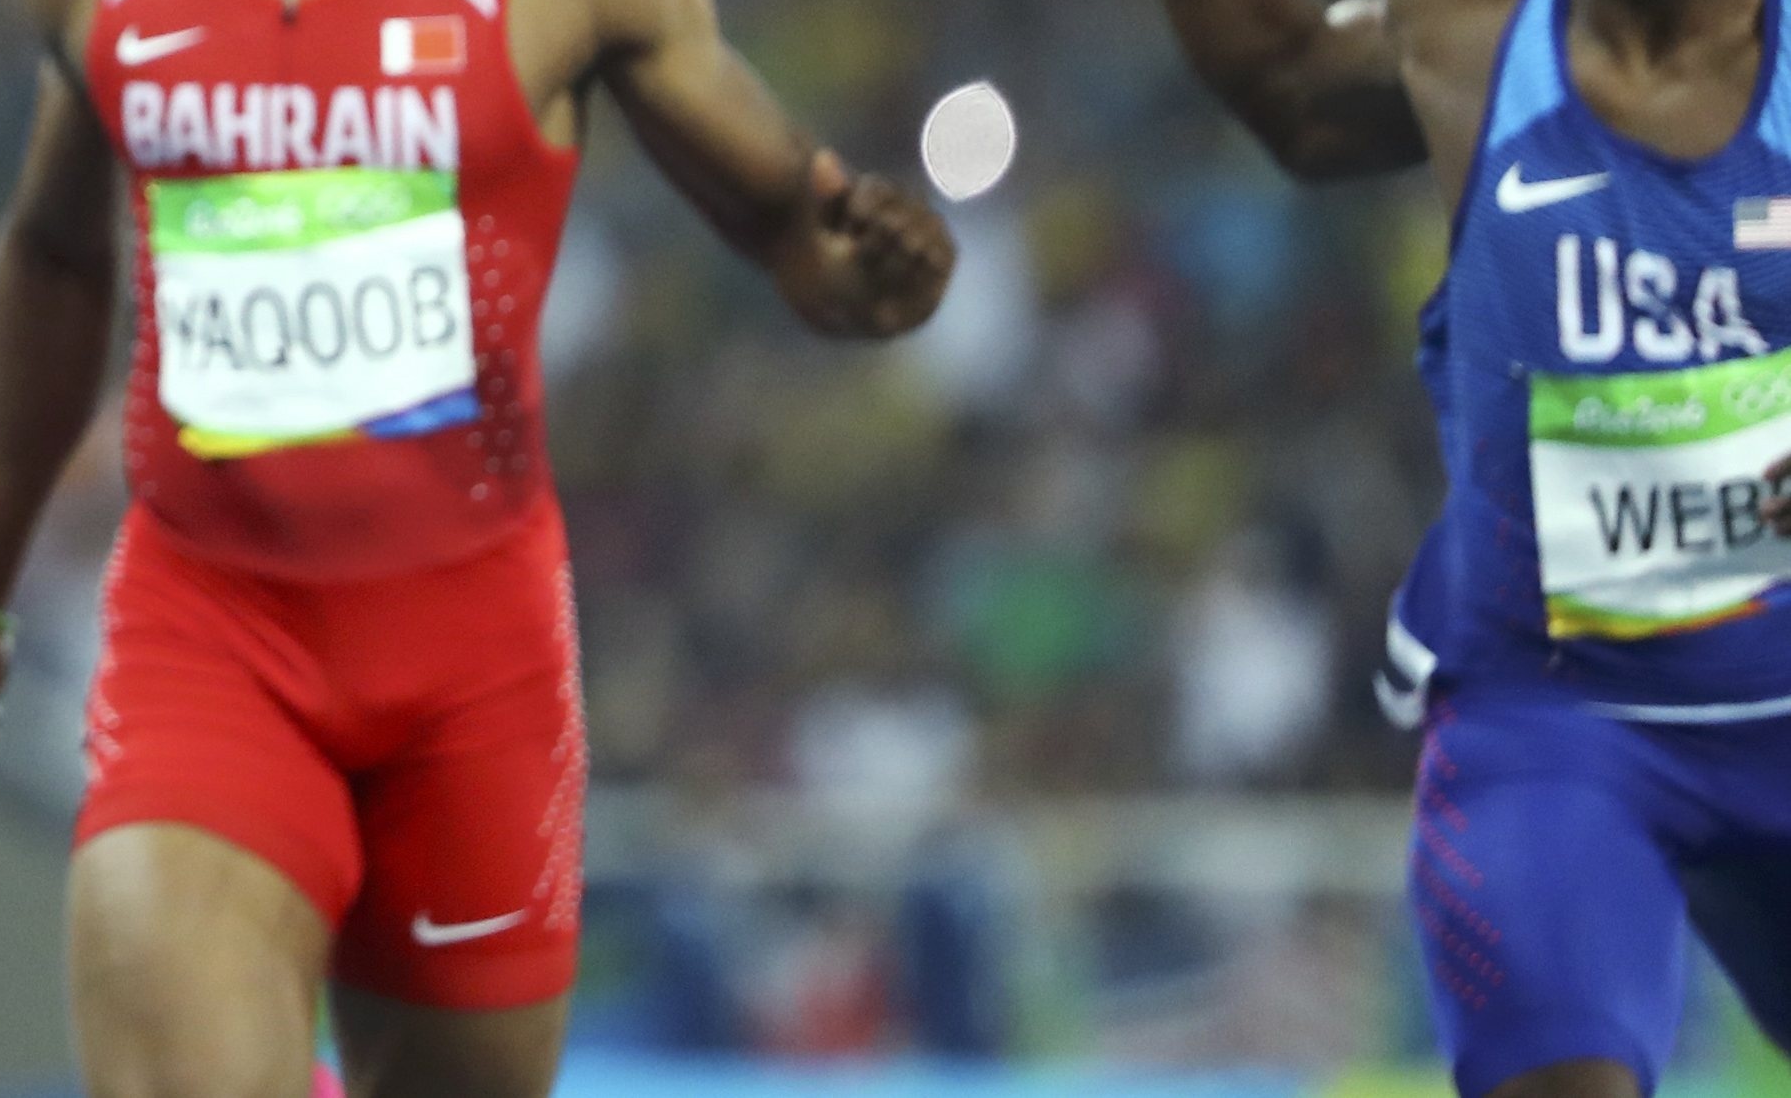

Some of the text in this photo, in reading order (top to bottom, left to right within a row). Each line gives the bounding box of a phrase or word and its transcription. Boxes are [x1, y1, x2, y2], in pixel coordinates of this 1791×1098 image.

[121, 80, 459, 167] BAHRAIN
[1556, 234, 1769, 363] USA
[1590, 477, 1783, 555] WEB
